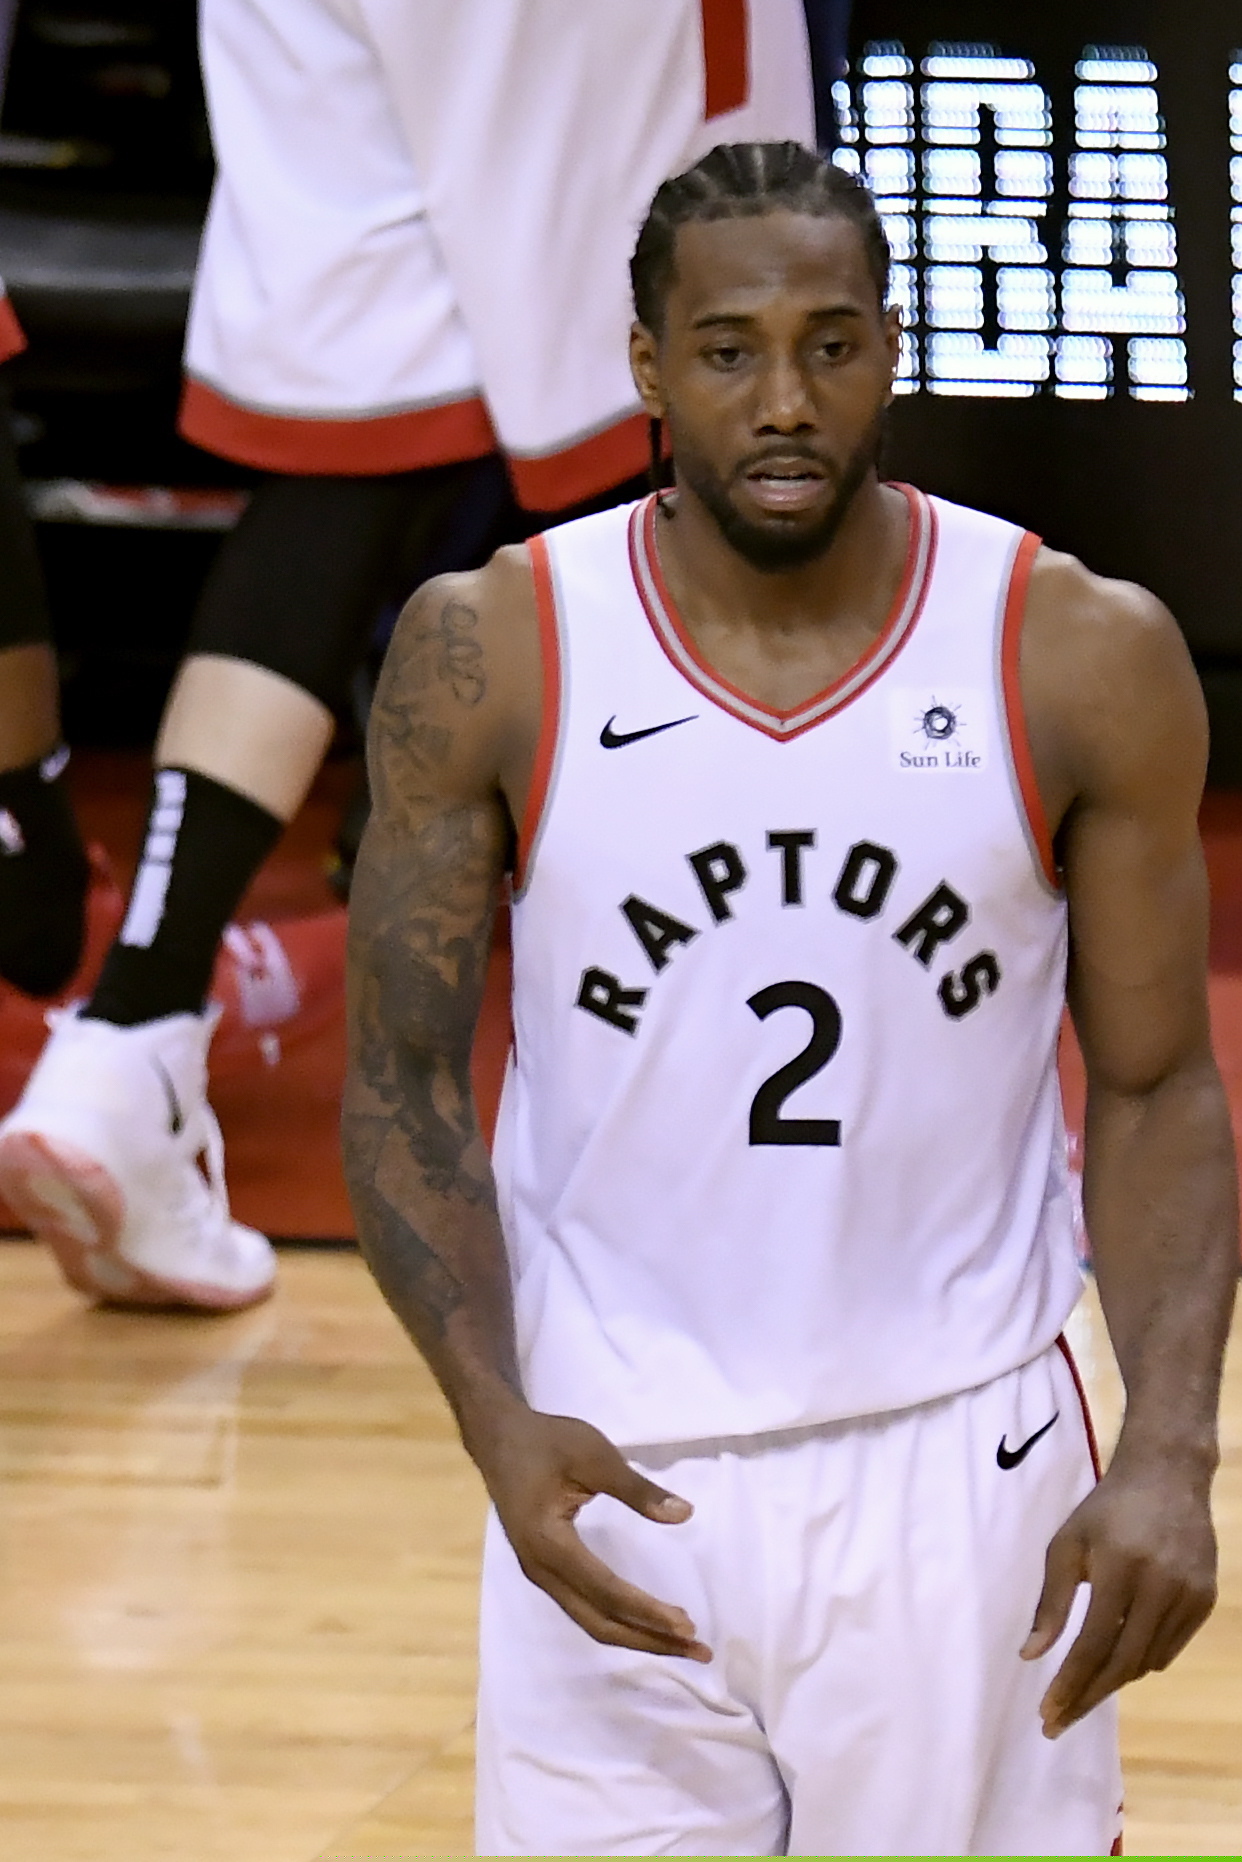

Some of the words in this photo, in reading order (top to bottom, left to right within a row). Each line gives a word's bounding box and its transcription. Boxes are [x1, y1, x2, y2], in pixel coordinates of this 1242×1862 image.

[900, 751, 938, 768] Sun
[945, 750, 981, 768] Life
[574, 828, 1002, 1038] RAPTORS
[746, 980, 844, 1147] 2
